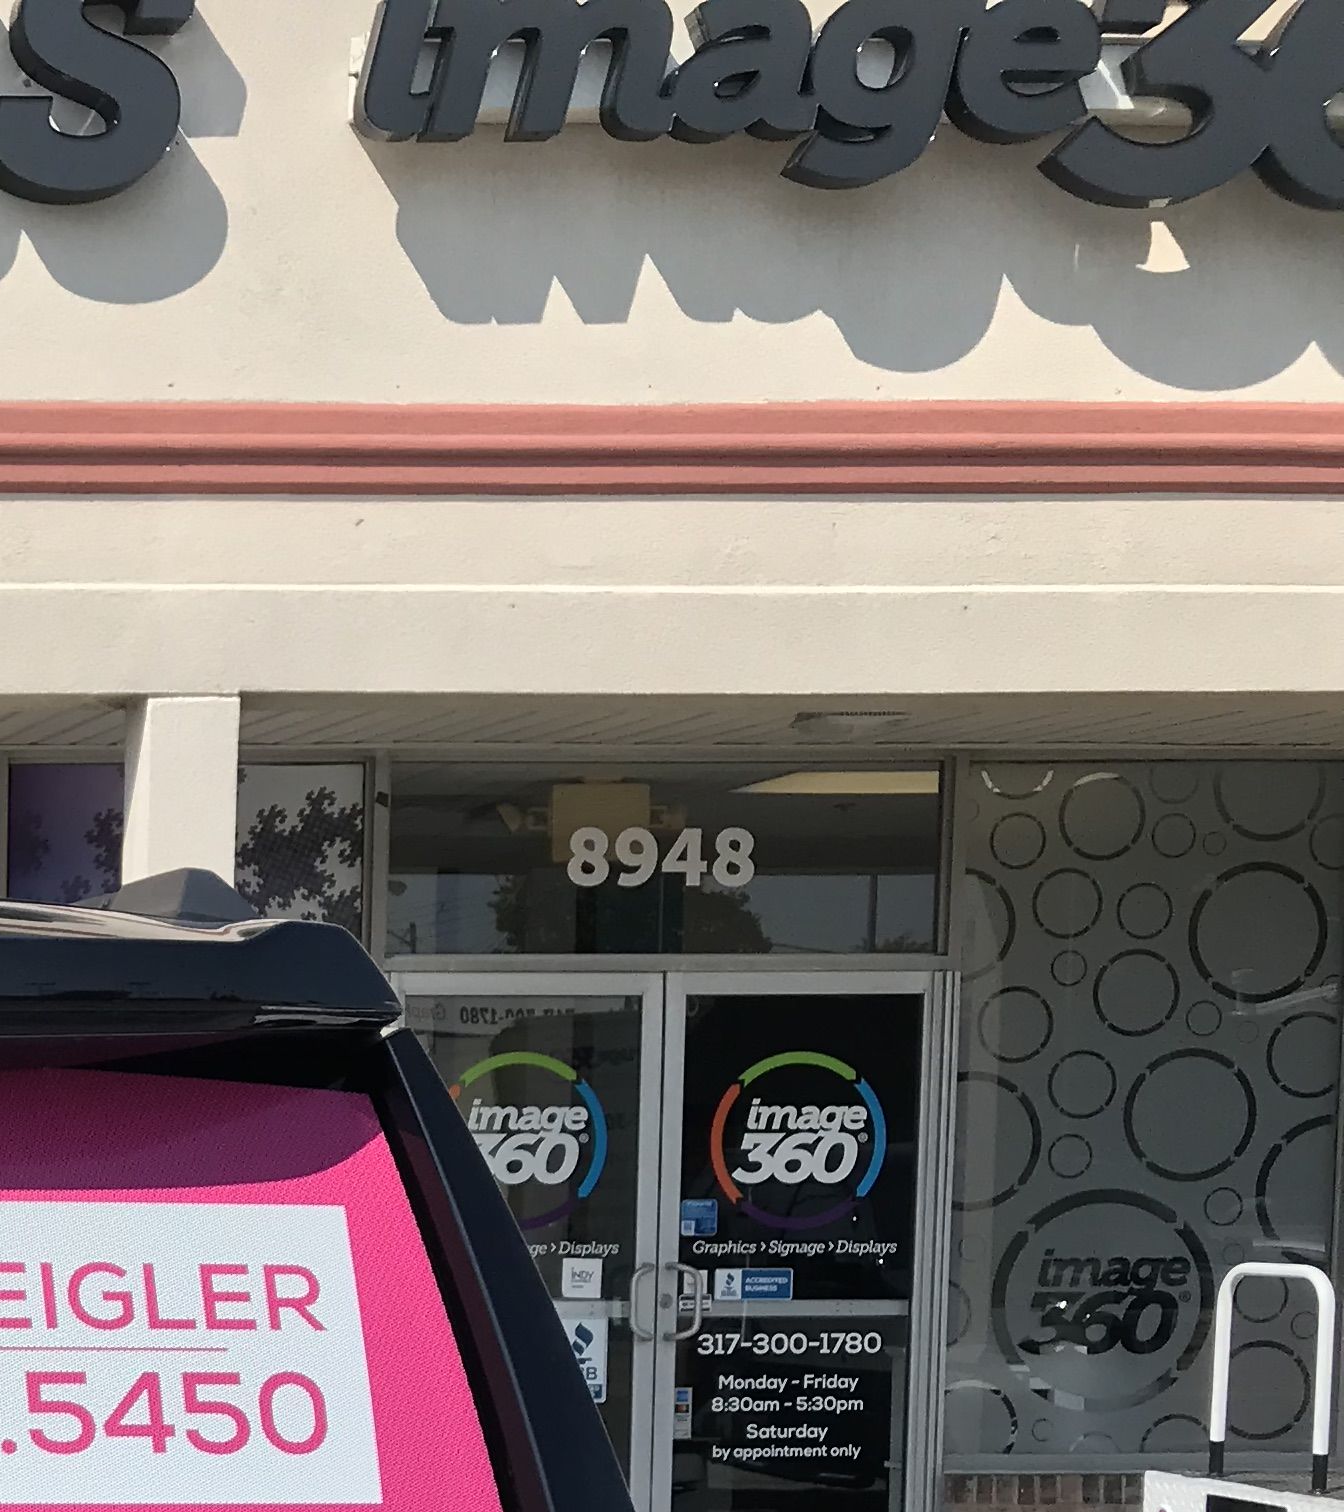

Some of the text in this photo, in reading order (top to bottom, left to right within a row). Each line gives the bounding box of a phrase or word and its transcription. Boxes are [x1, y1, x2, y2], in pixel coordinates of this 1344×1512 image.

[566, 826, 756, 888] 8948
[467, 1098, 589, 1137] image
[746, 1098, 868, 1136] image
[731, 1132, 859, 1185] 360
[558, 1240, 621, 1258] Displays
[692, 1240, 898, 1258] Graphics Signage Displays
[1037, 1248, 1191, 1290] image
[1017, 1289, 1178, 1356] 360
[697, 1332, 882, 1355] 317-300-1780
[717, 1374, 789, 1393] Monday
[803, 1373, 859, 1393] Friday
[711, 1396, 780, 1412] 8:30am
[796, 1396, 864, 1415] 5:30pm
[745, 1423, 829, 1442] Saturday
[712, 1443, 862, 1461] by appointment only
